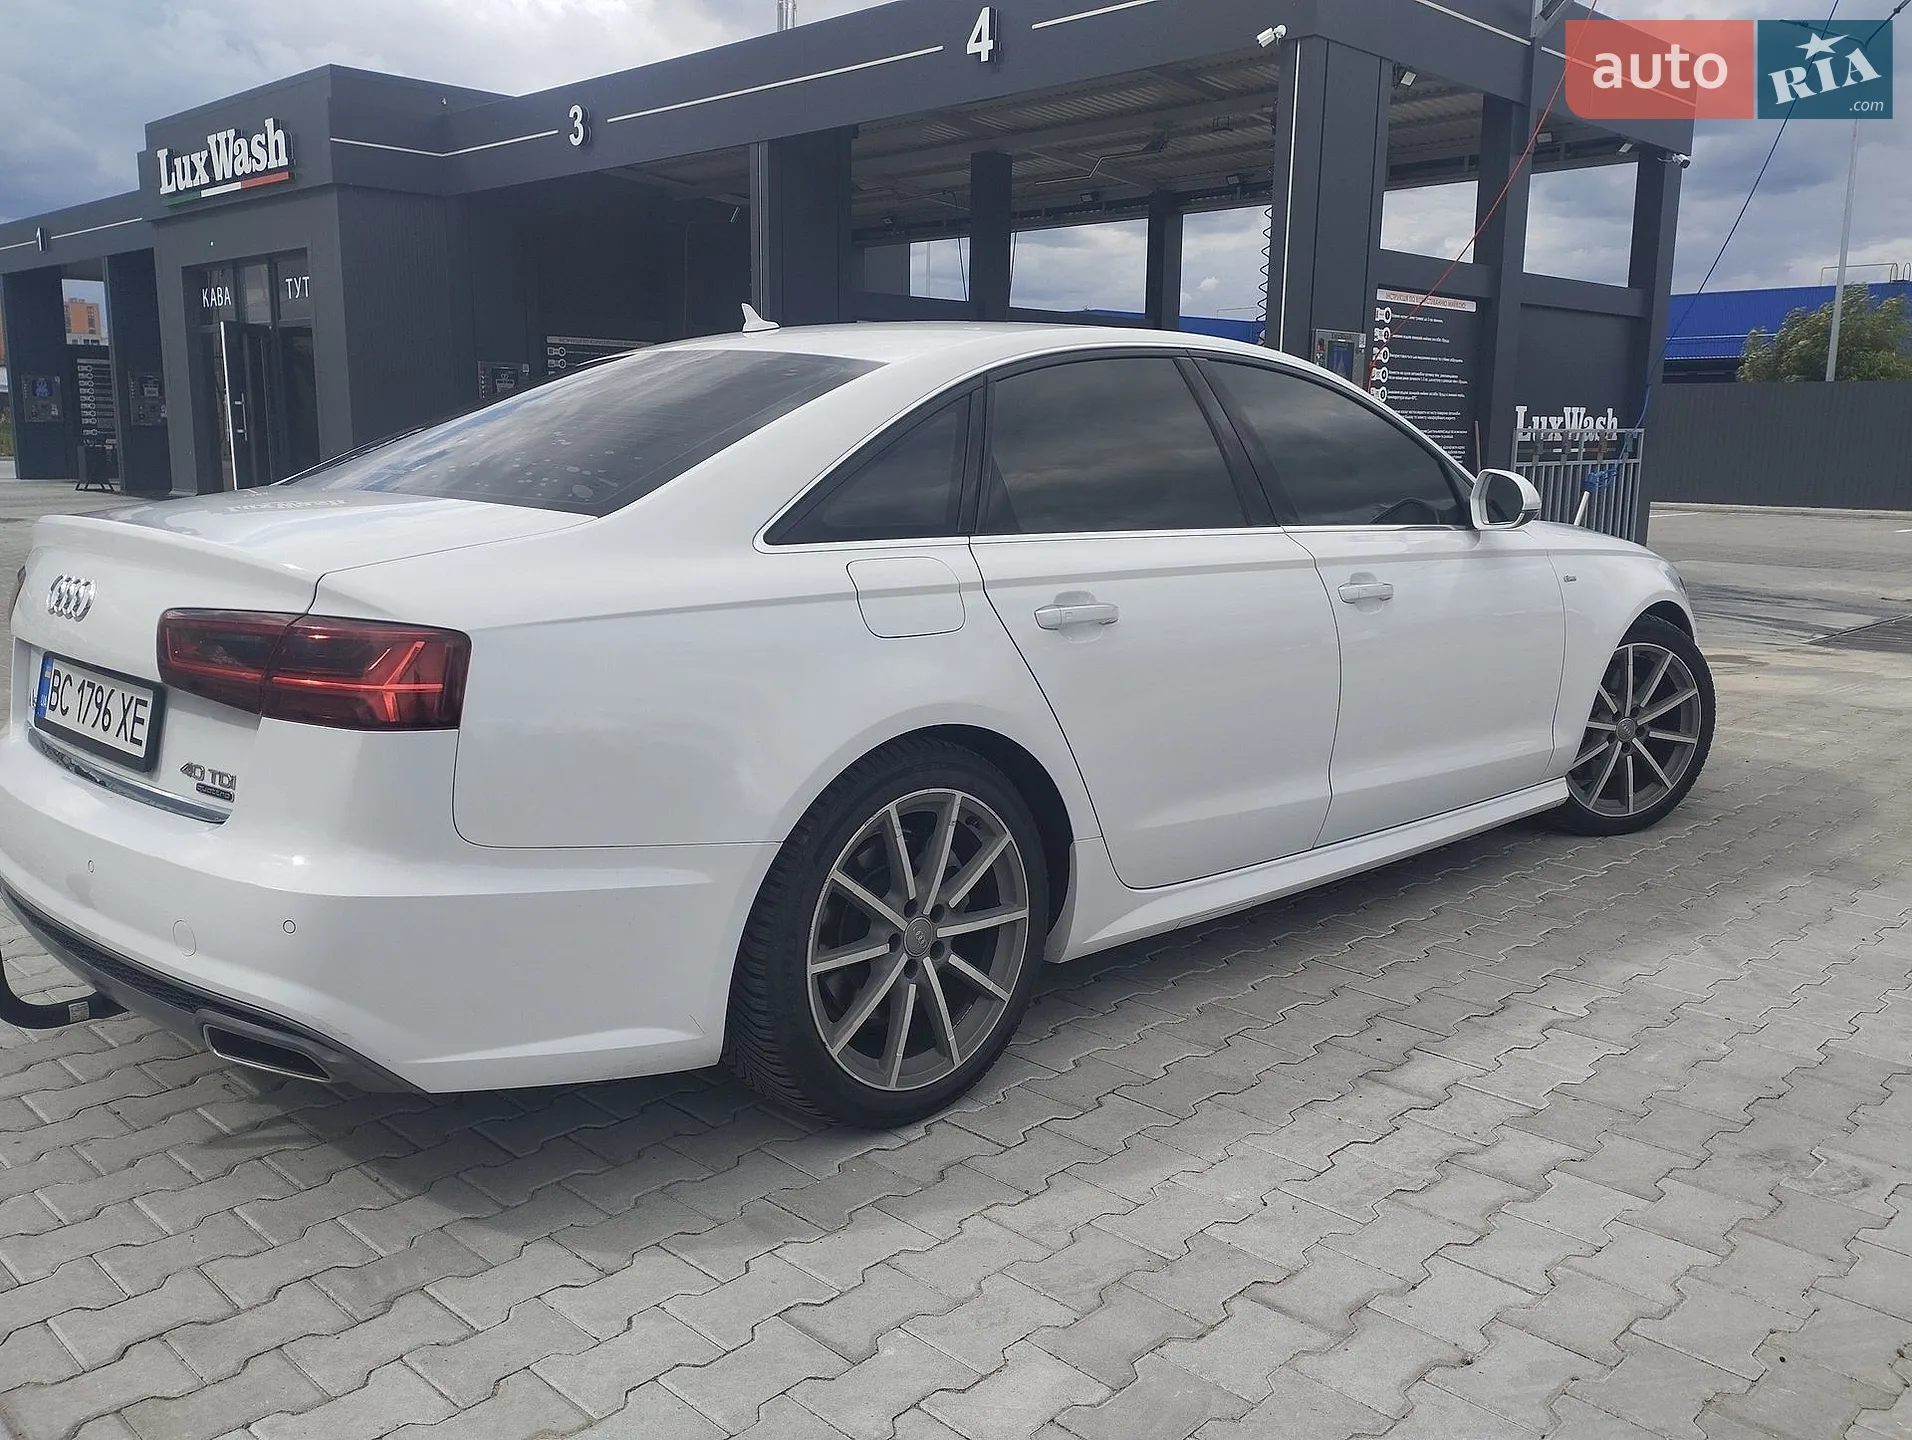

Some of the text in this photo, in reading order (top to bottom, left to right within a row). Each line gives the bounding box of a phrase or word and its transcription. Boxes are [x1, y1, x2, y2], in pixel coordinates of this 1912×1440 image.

[966, 6, 994, 63] 4
[569, 104, 584, 146] 3
[202, 276, 310, 309] КАВА ТУТ
[48, 668, 148, 747] BC 1796 XE
[179, 761, 237, 790] 40 TDI
